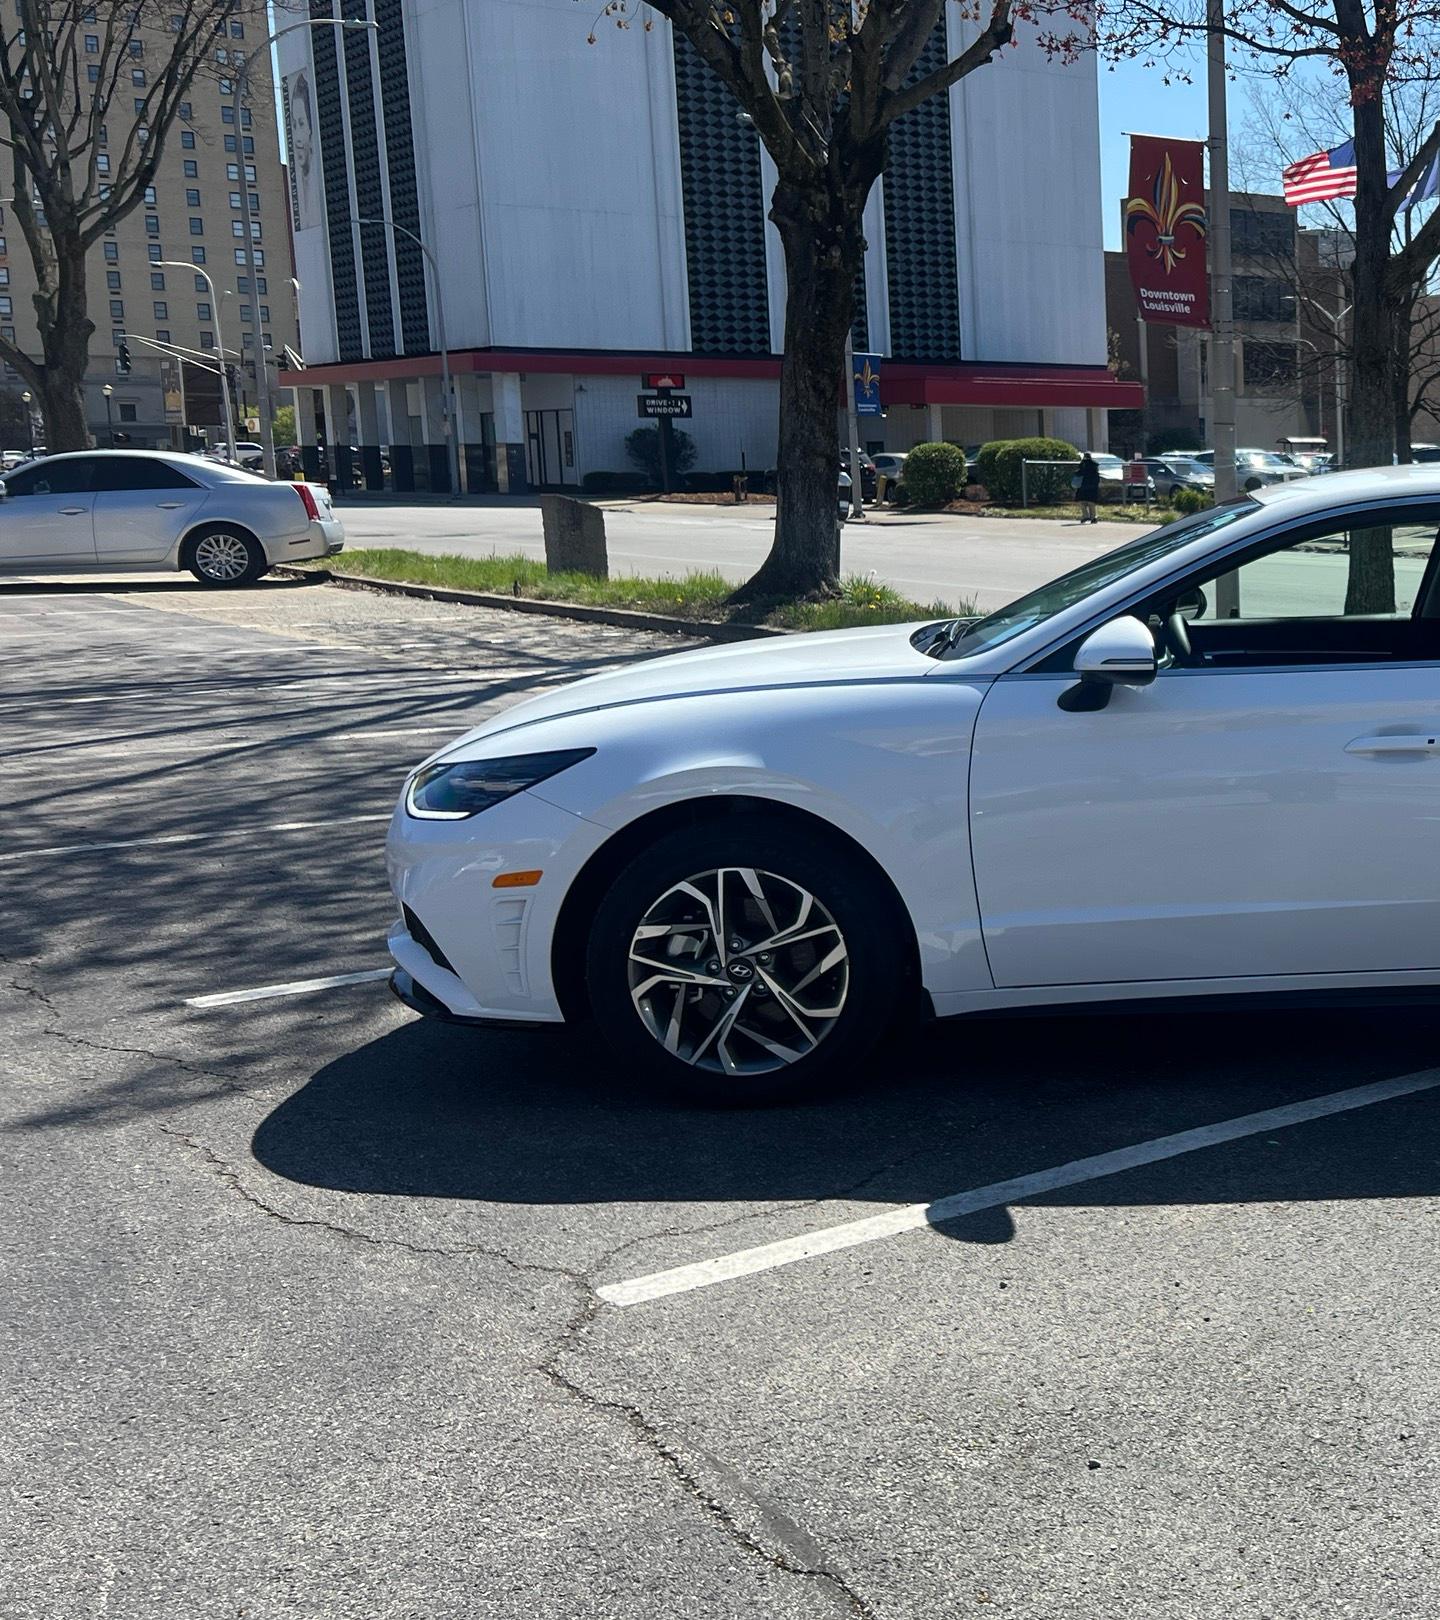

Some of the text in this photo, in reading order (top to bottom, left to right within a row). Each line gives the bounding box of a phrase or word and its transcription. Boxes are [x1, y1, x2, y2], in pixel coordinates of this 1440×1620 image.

[1140, 288, 1195, 302] Downtown
[1143, 300, 1191, 314] Louisville
[646, 406, 681, 414] WINDOW
